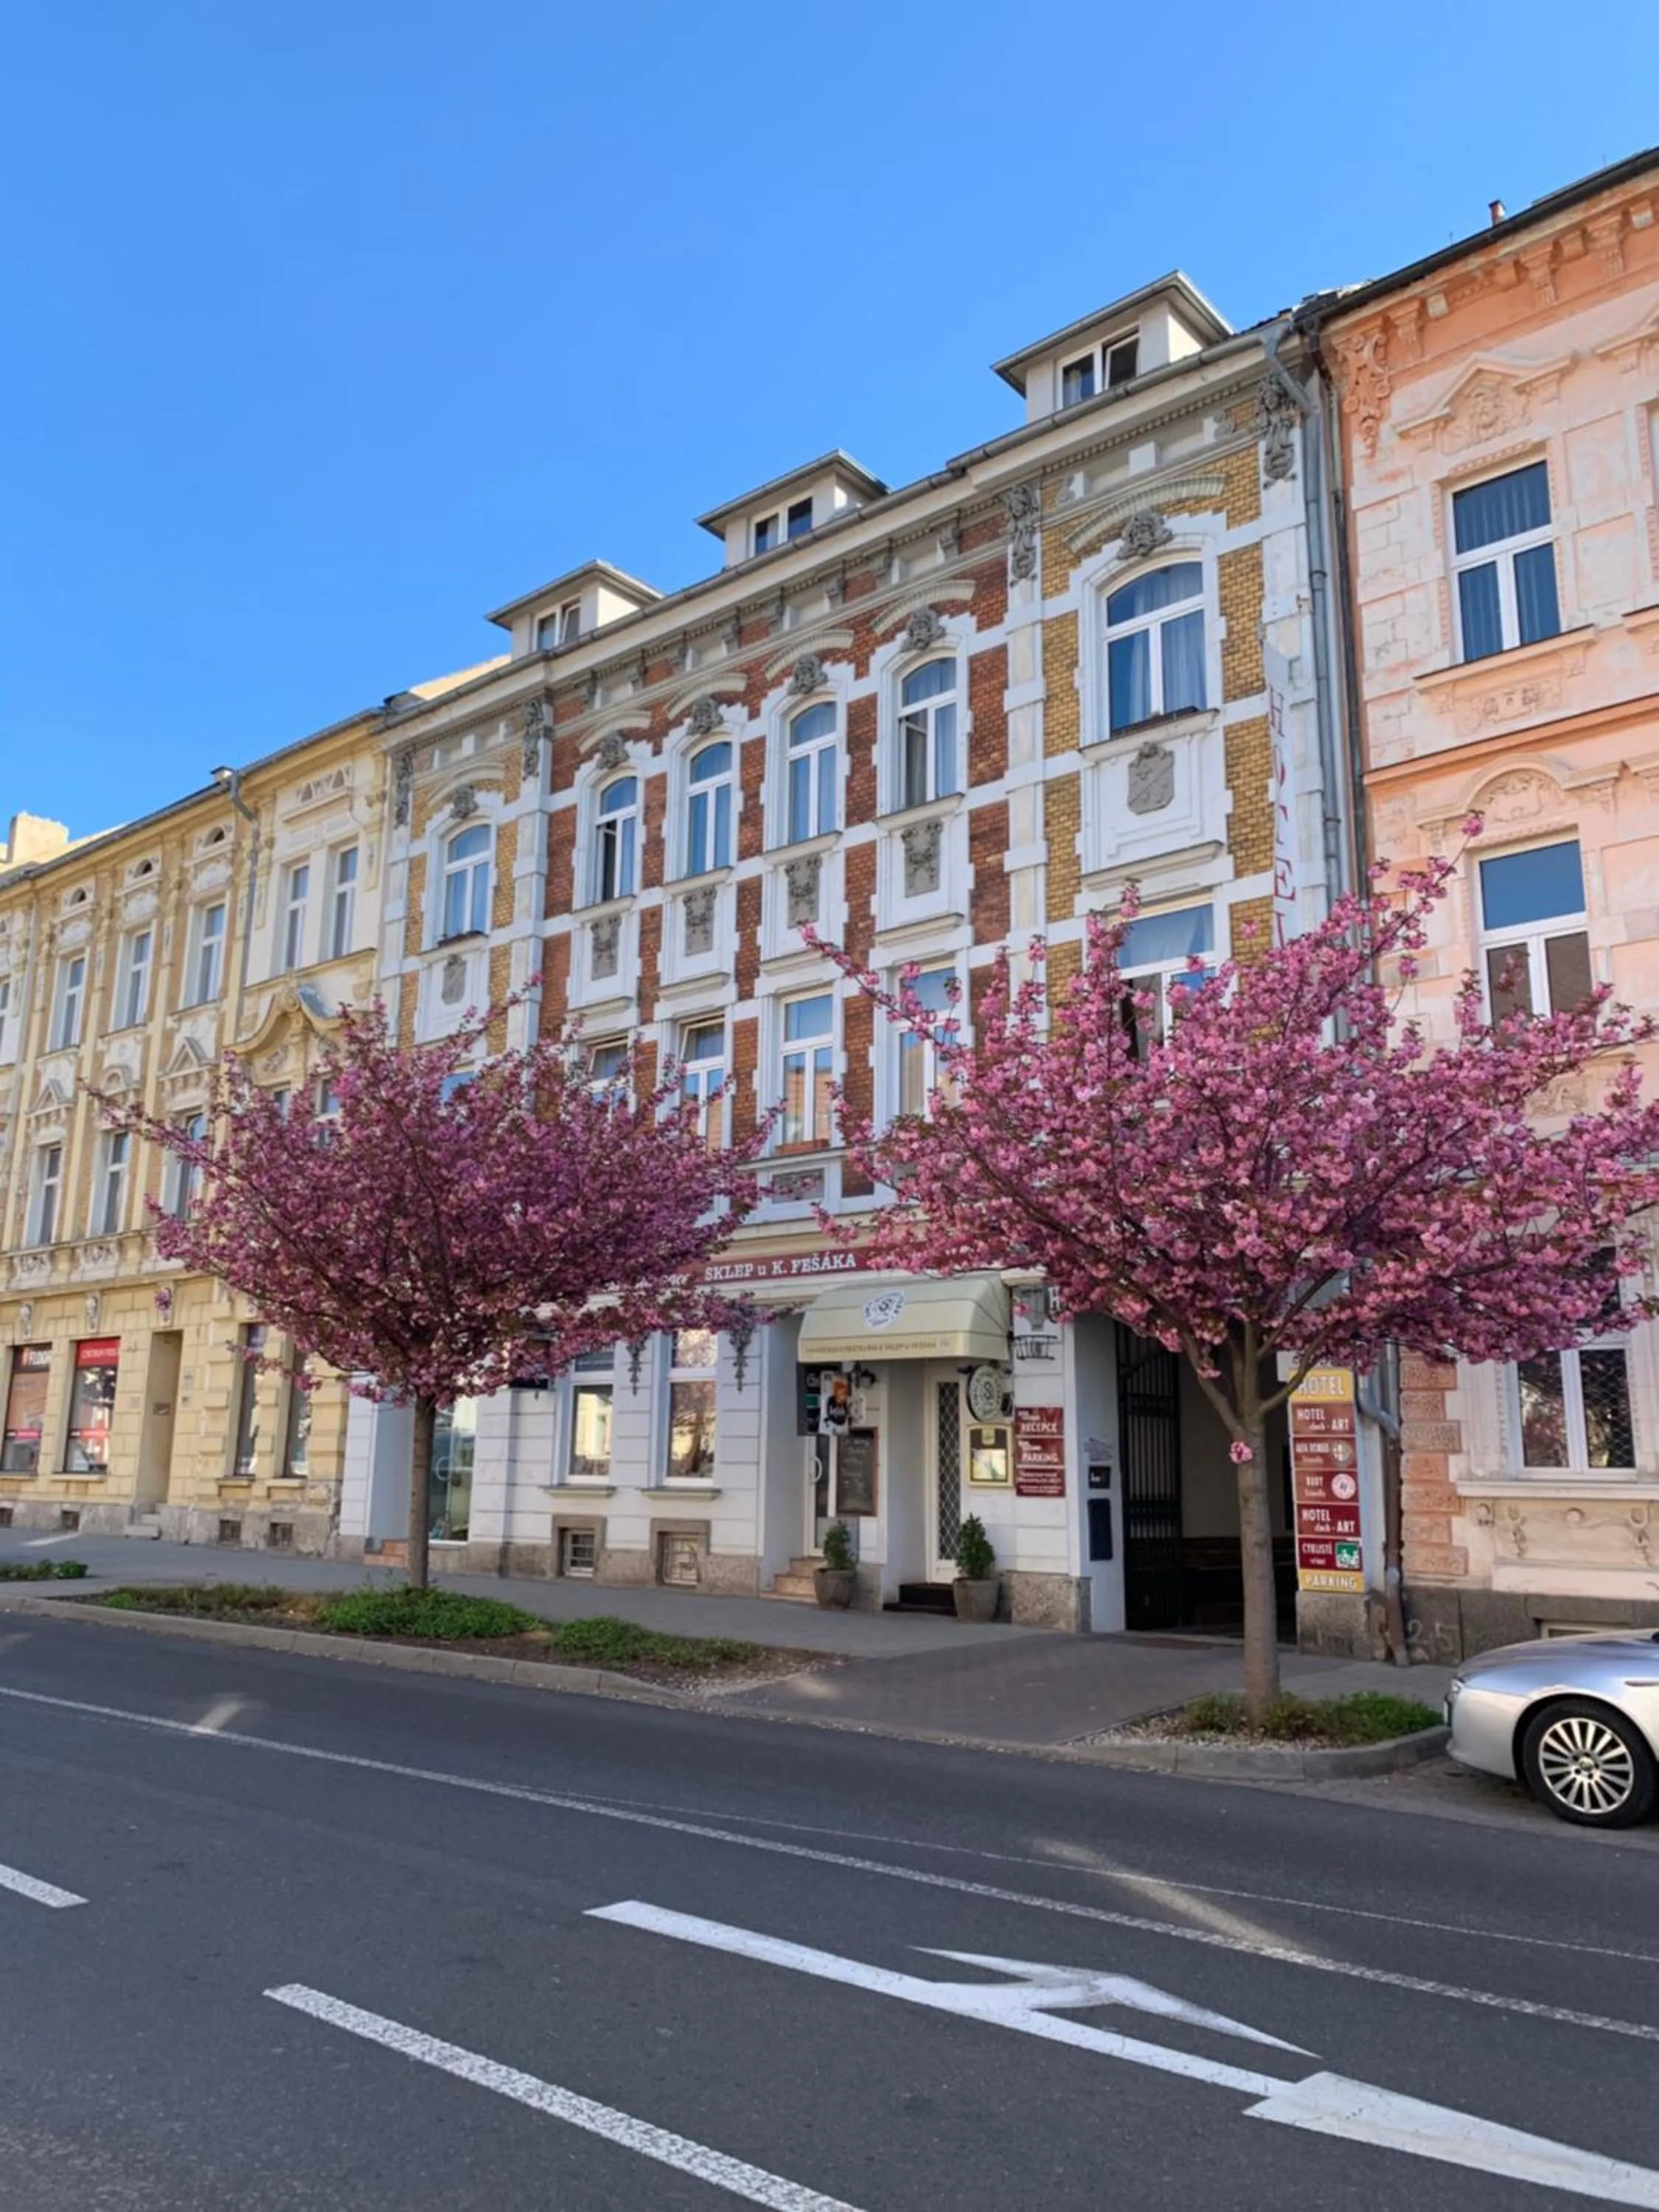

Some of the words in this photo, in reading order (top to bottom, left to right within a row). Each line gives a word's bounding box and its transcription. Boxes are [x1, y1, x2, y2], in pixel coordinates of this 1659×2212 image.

[705, 1263, 754, 1281] SKLEP
[757, 1264, 767, 1276] u
[772, 1259, 787, 1275] K.
[791, 1251, 856, 1273] FEŠÁKA
[1298, 1375, 1345, 1395] HOTEL
[1296, 1408, 1325, 1420] HOTEL
[1332, 1418, 1350, 1430] ART
[1301, 1509, 1330, 1521] HOTEL
[1337, 1520, 1355, 1533] ART
[1306, 1575, 1357, 1590] PARKING
